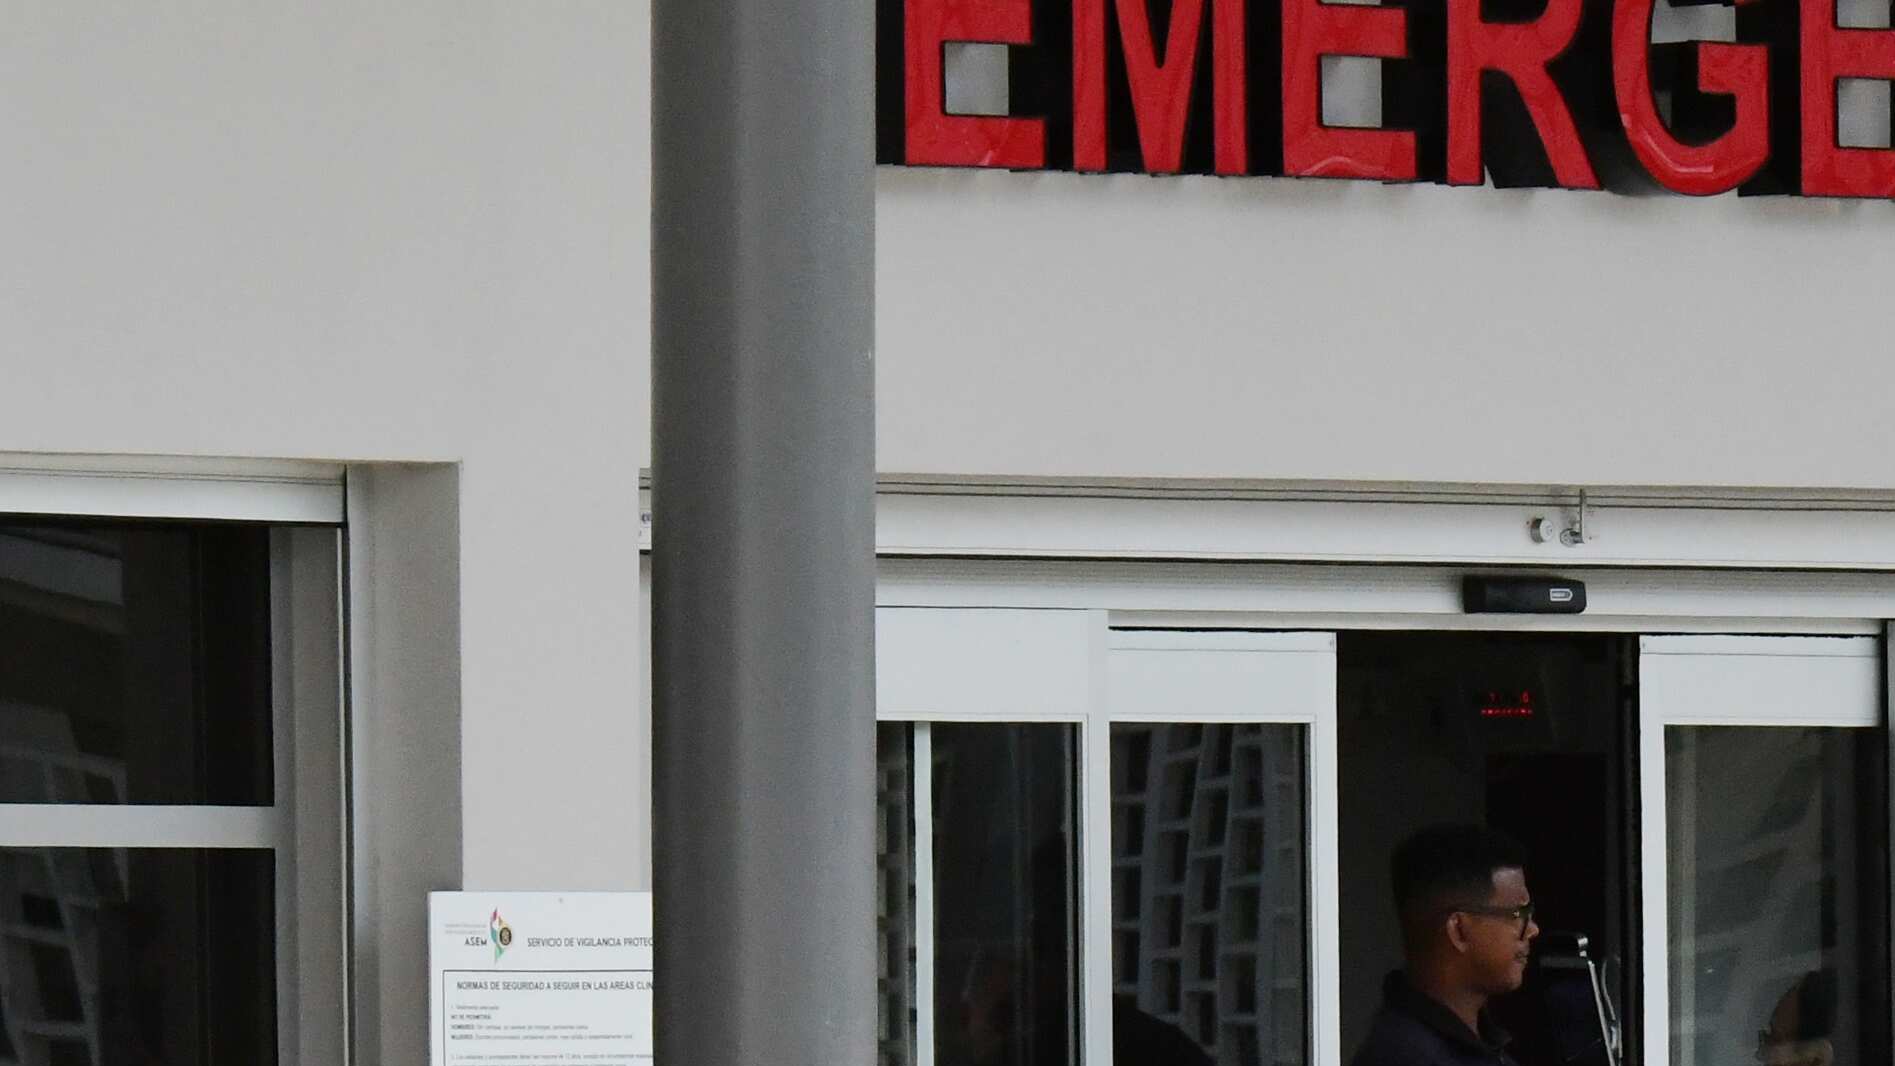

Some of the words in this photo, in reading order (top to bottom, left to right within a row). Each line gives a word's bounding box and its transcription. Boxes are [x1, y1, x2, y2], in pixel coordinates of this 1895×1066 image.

[464, 937, 488, 946] ASEM
[527, 938, 562, 947] SERVICIO
[564, 938, 574, 947] DE
[576, 938, 621, 947] VIGILANCIA
[623, 938, 653, 946] PROTEC
[457, 981, 488, 990] NORMAS
[490, 981, 500, 990] DE
[502, 981, 545, 990] SEGURIDAD
[546, 982, 551, 990] A
[553, 981, 580, 990] SEGUIR
[582, 981, 592, 990] EN
[593, 981, 608, 990] LAS
[610, 981, 634, 990] AREAS
[636, 981, 653, 990] CLIN
